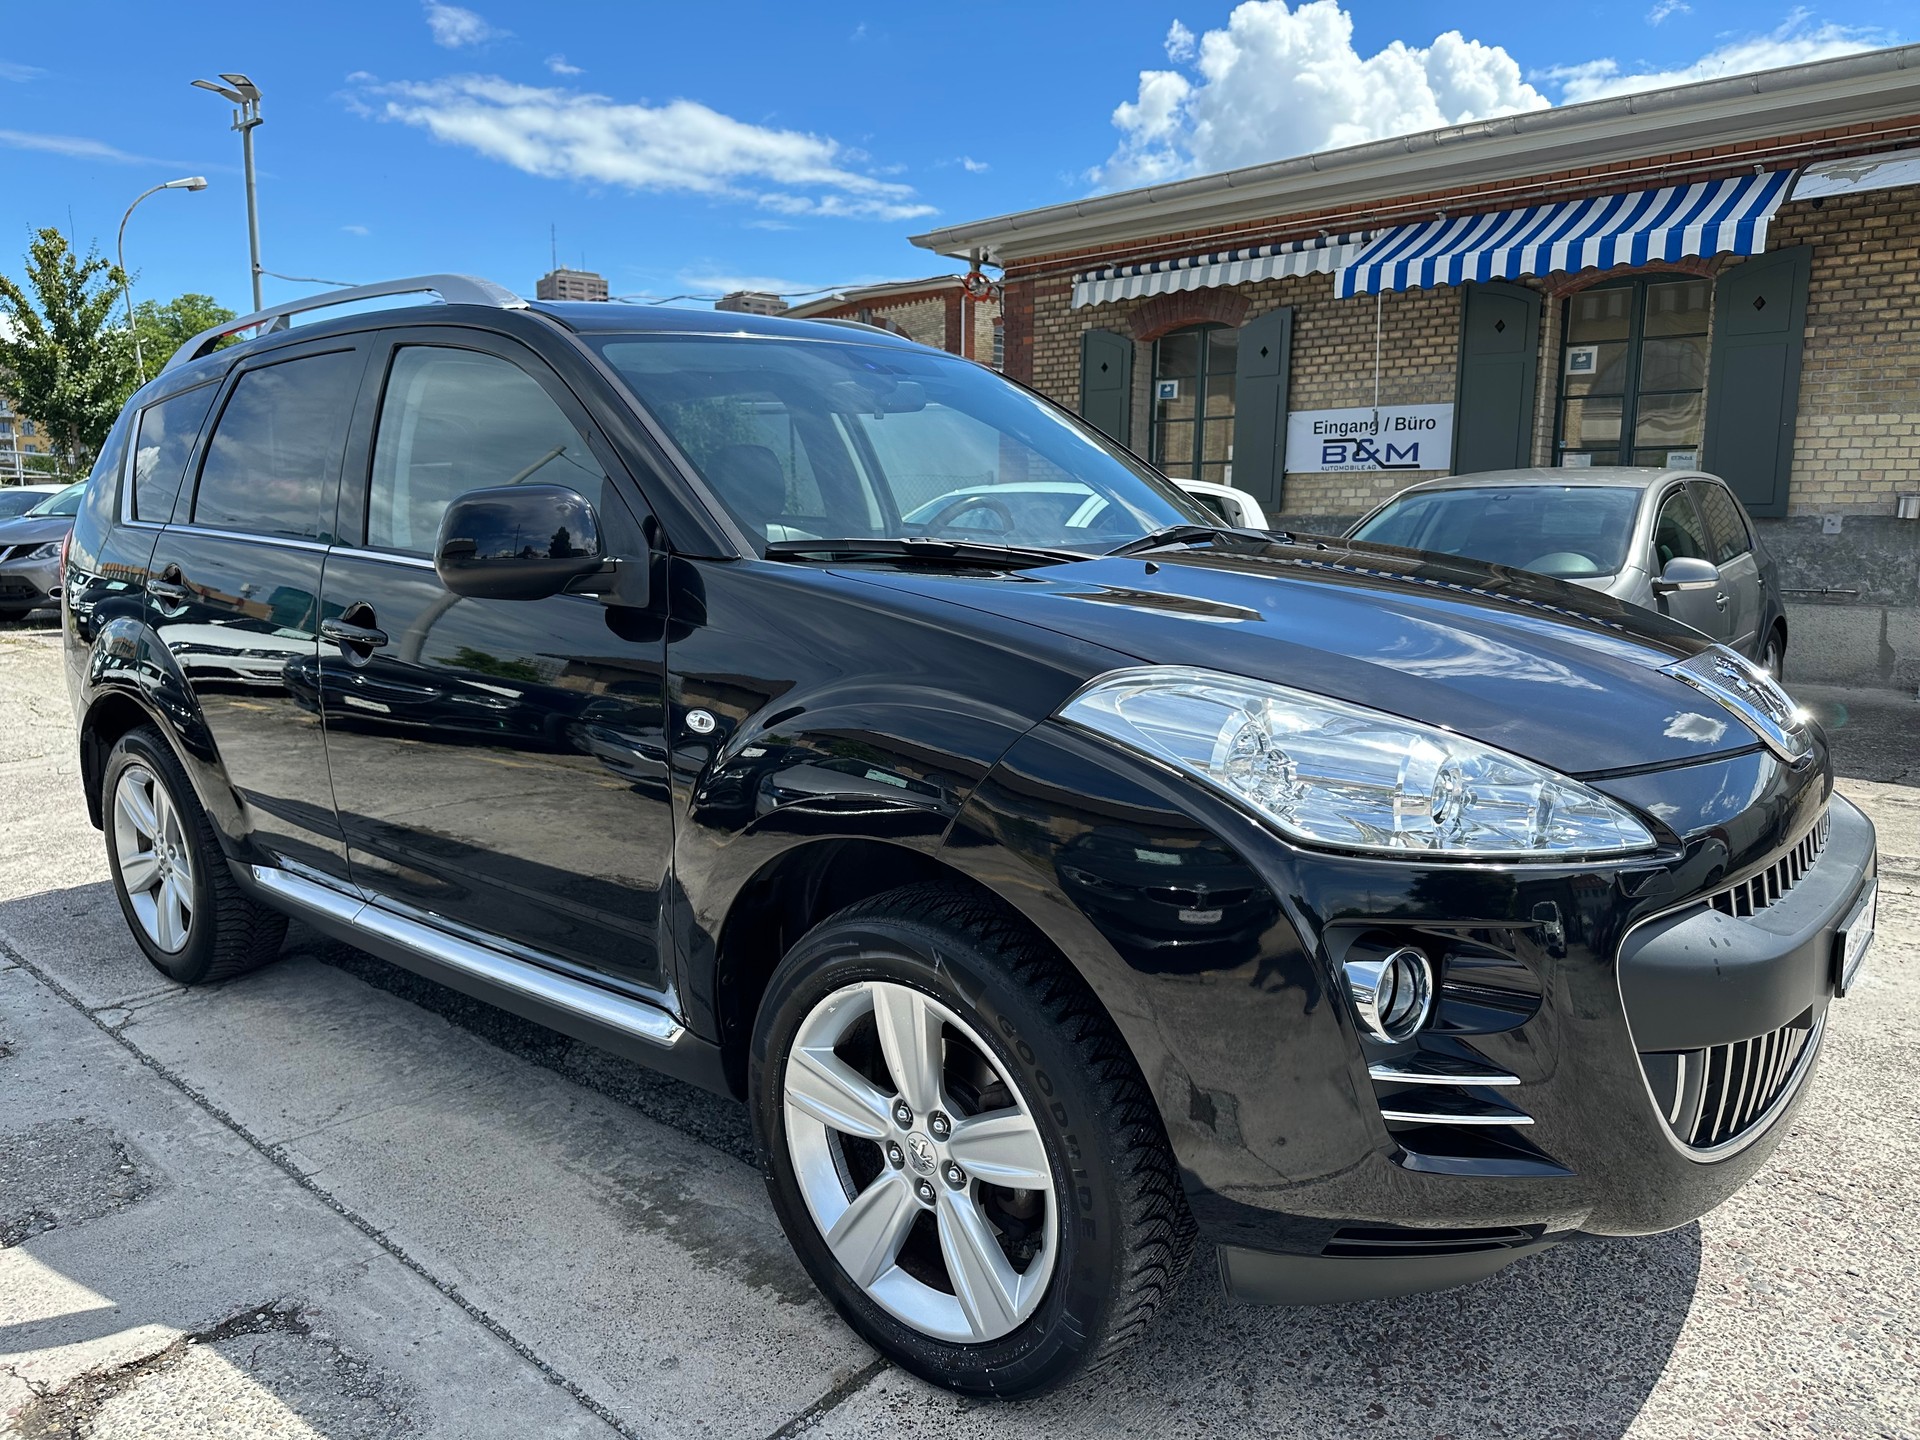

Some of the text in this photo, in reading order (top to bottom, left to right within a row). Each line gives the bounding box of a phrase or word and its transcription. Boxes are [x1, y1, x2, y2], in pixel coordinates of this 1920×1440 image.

[1313, 416, 1436, 437] Eingang / Büro
[1321, 438, 1420, 465] B&M
[997, 1014, 1097, 1241] GOODRIDE
